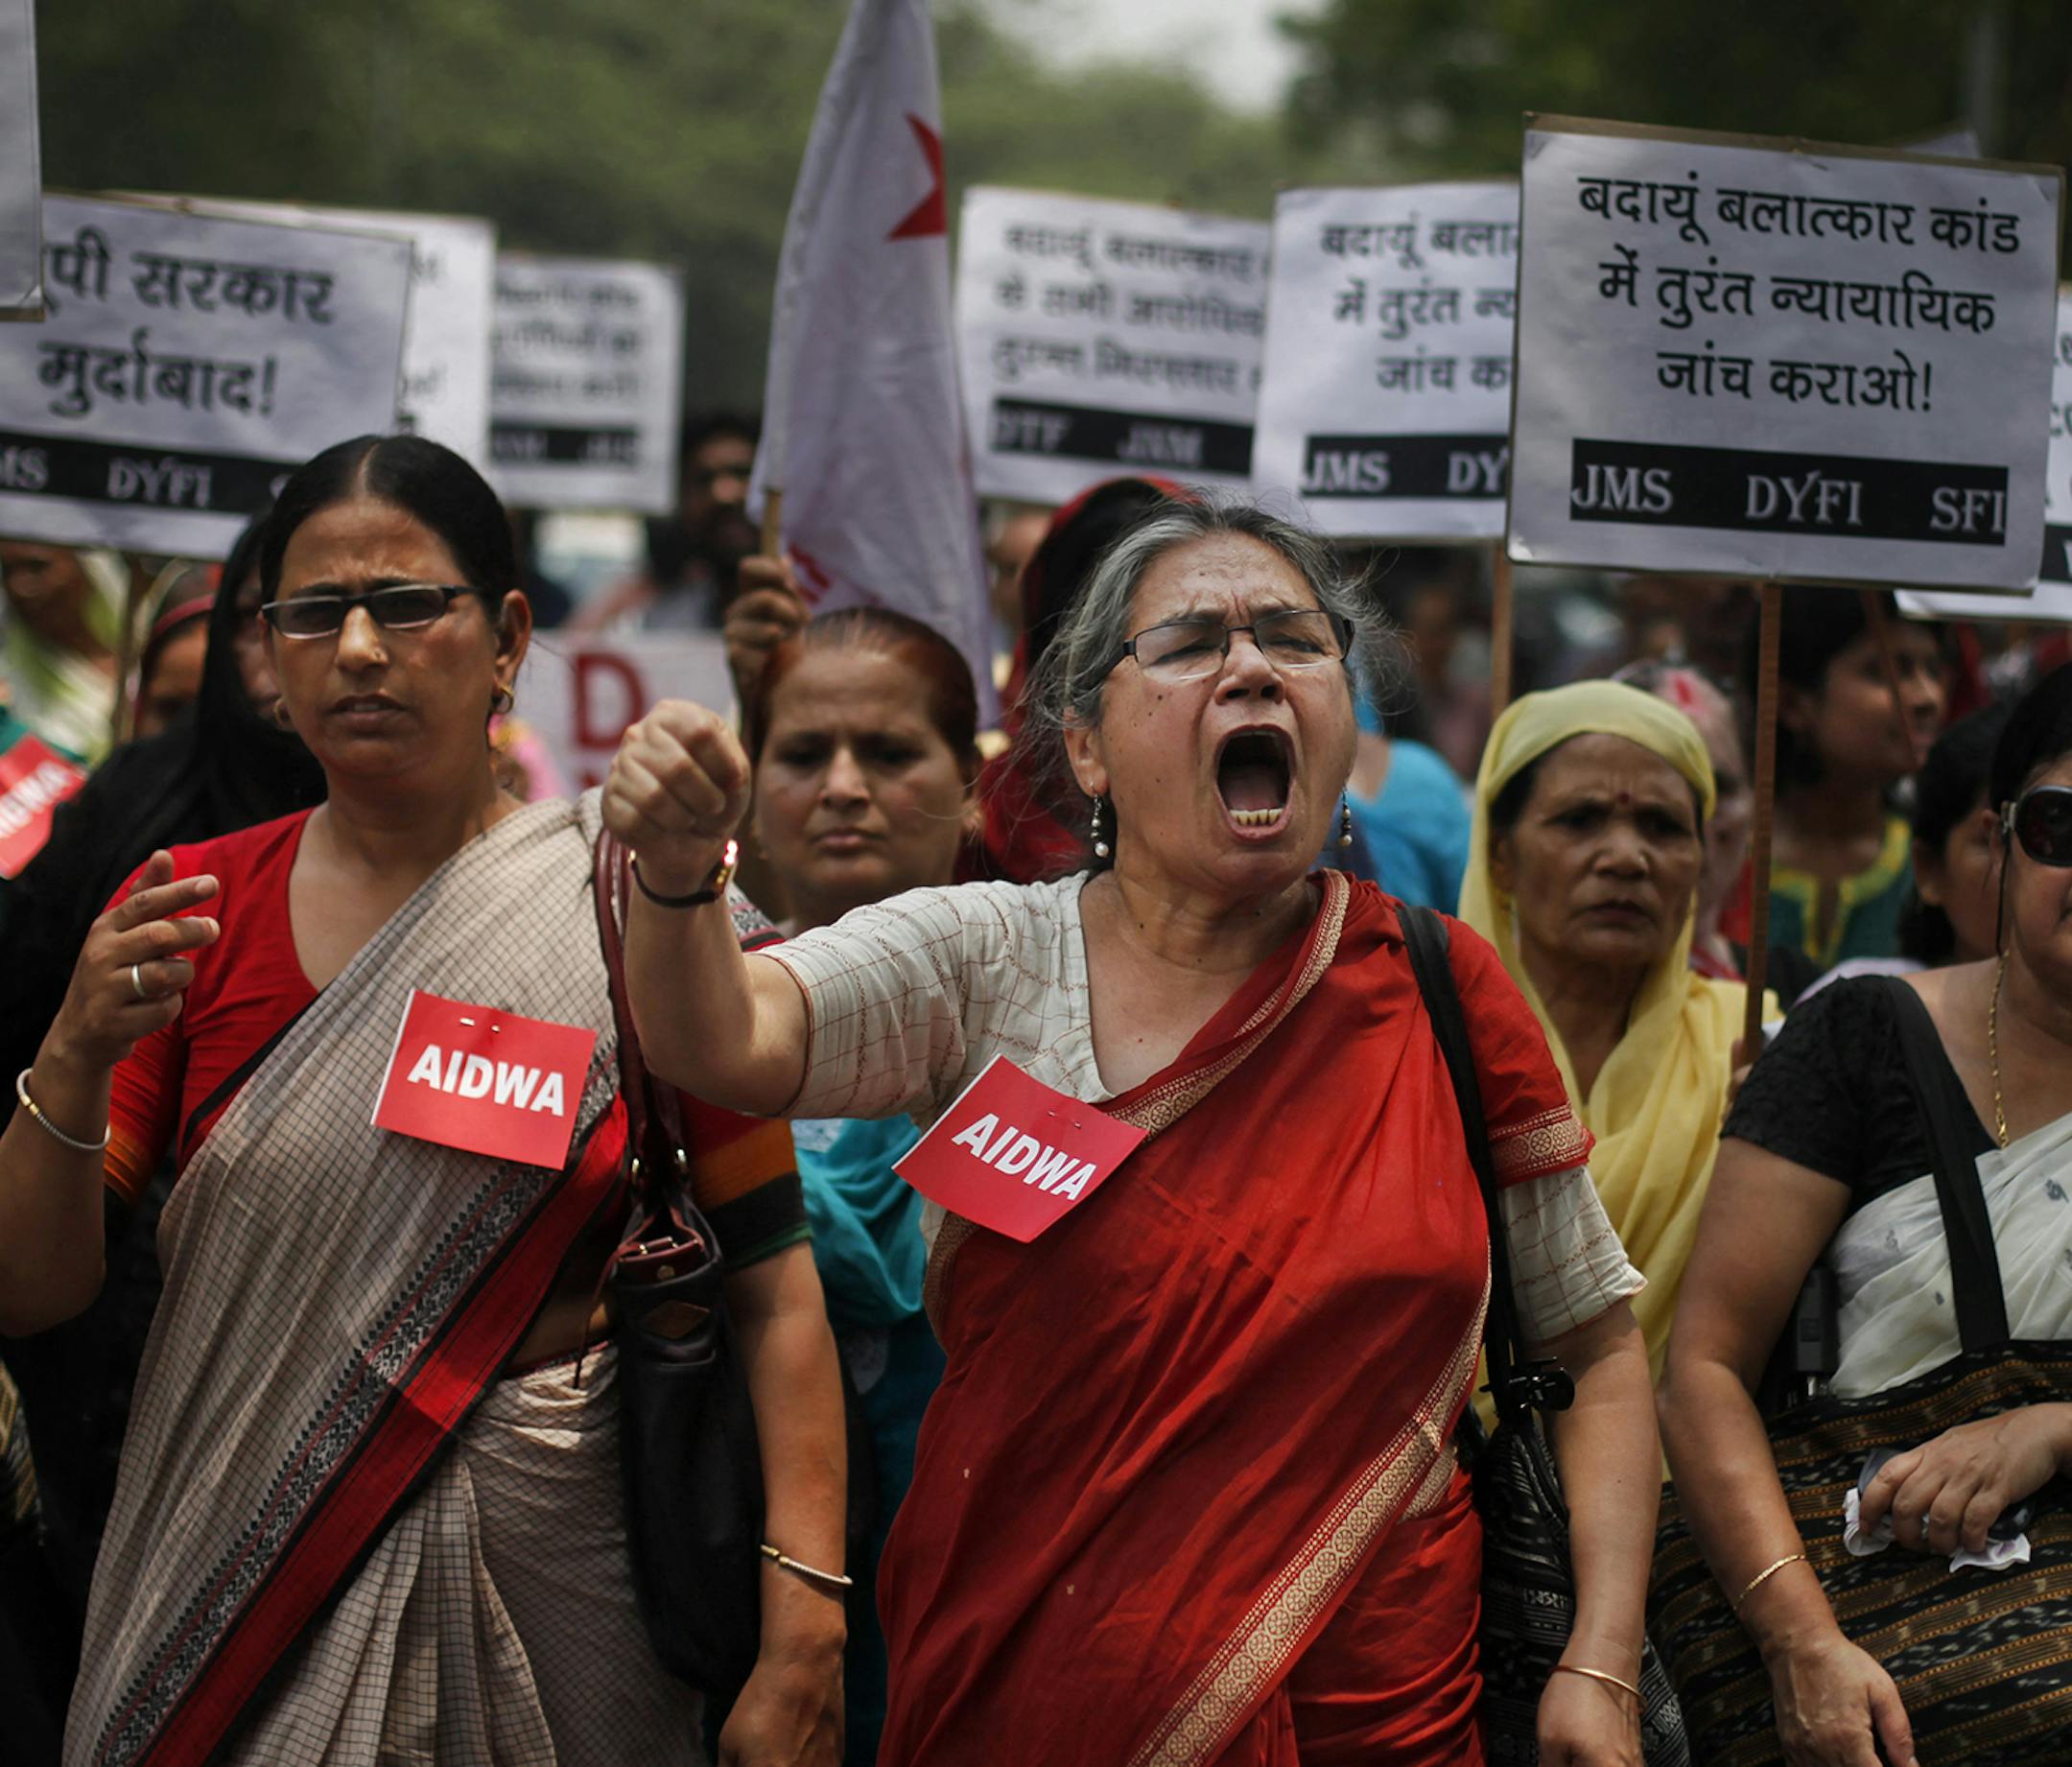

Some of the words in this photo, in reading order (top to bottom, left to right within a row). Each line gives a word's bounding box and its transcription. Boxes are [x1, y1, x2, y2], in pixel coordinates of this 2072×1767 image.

[1578, 170, 1709, 246] बदायूं
[1716, 185, 1917, 246] बलात्कार
[1929, 197, 2021, 253] कांड
[130, 250, 337, 325] सरकार
[1334, 276, 1366, 325] में
[1378, 275, 1461, 341] तुरंत
[1598, 243, 1639, 307] में
[1656, 256, 1755, 329] तुरंत
[1770, 270, 1996, 335] न्यायायिक
[37, 325, 277, 419] मुर्दाबाद!
[1376, 345, 1459, 392] जांच
[1656, 340, 1753, 398] जांच
[1769, 348, 1933, 412] कराओ!
[1302, 450, 1391, 493] JMS
[1447, 448, 1509, 493] DY
[1570, 463, 1673, 514] JMS
[1745, 468, 1863, 527] DYFI
[1929, 485, 2006, 535] SFI
[407, 1043, 564, 1118] AIDWA
[951, 1112, 1096, 1201] AIDWA
